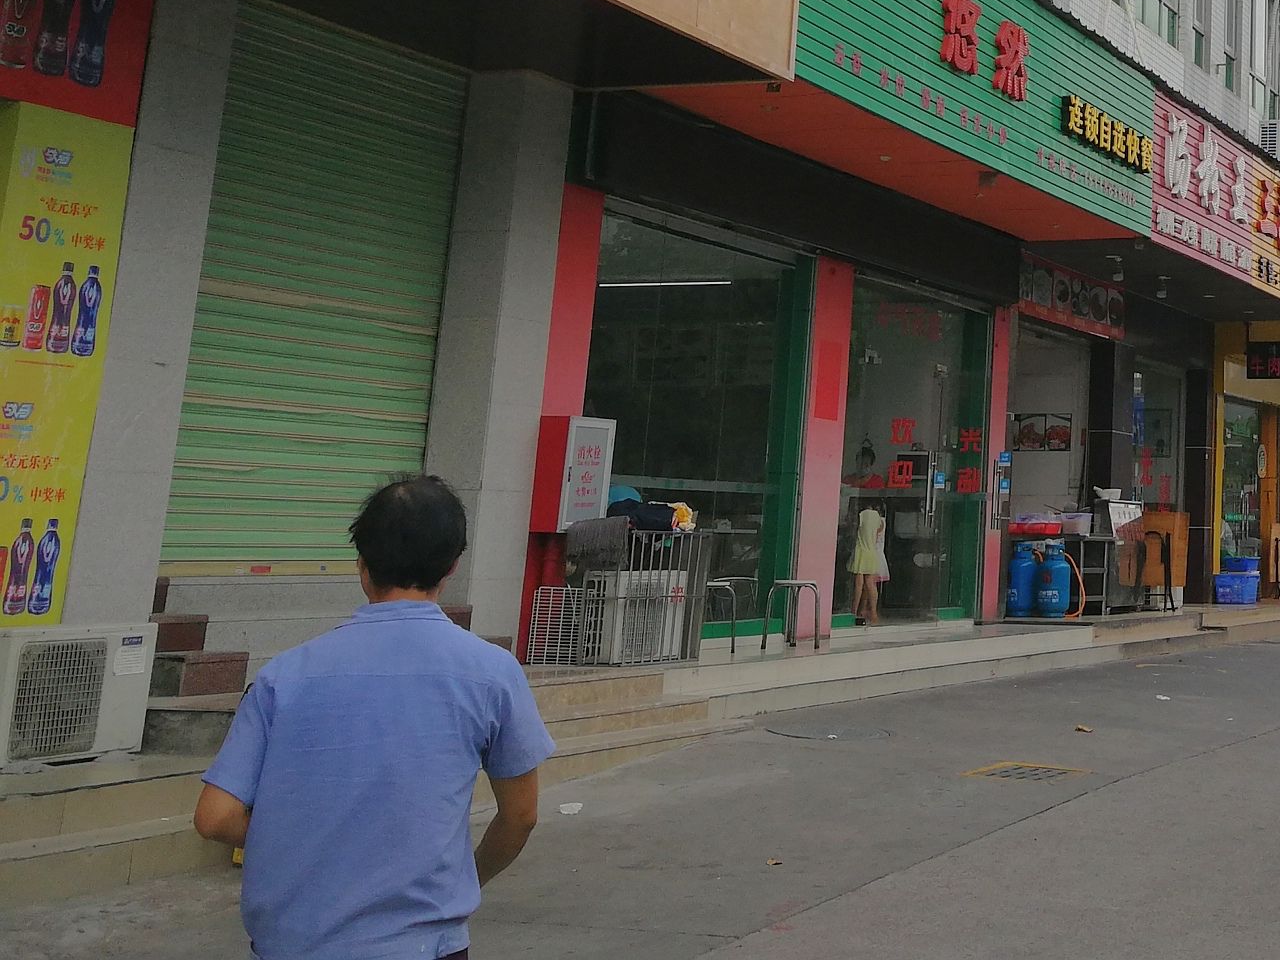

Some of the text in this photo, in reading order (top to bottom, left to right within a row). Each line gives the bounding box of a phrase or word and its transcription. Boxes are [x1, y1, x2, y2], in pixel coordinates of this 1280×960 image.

[1068, 95, 1154, 172] 连锁自选快餐
